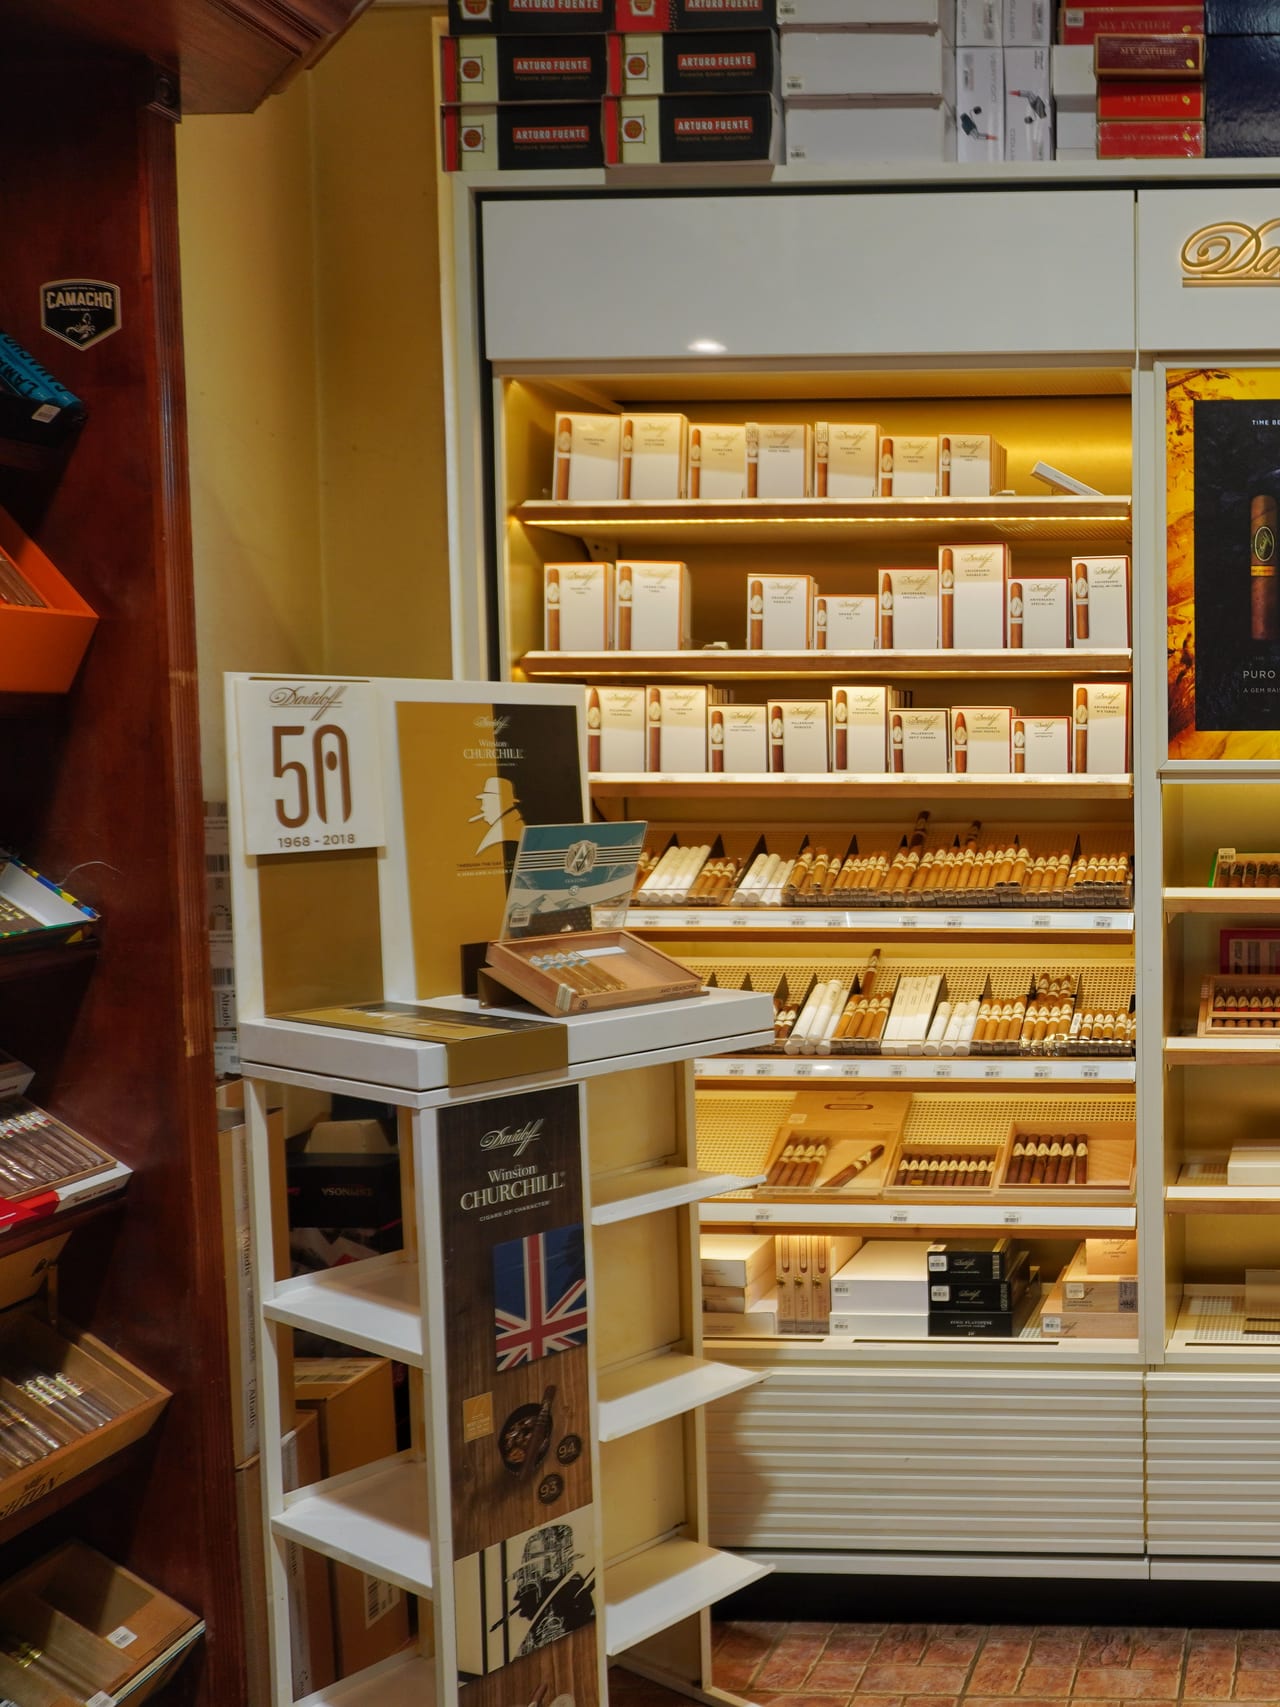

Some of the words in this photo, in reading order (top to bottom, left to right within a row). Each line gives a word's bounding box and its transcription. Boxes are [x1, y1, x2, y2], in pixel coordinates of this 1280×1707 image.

[513, 0, 554, 8] ARTURO
[557, 0, 599, 8] FUENTE
[688, 0, 723, 8] ARTURO
[725, 0, 759, 8] FUENTE
[961, 0, 969, 40] VERTIG
[1098, 21, 1116, 30] MY
[1121, 20, 1171, 30] FATHER
[1120, 47, 1135, 55] MY
[1138, 47, 1177, 56] FATHER
[516, 61, 551, 70] ARTURO
[553, 60, 588, 70] FUENTE
[681, 56, 715, 67] ARTURO
[718, 55, 752, 66] FUENTE
[678, 120, 713, 130] ARTURO
[715, 119, 749, 129] FUENTE
[516, 129, 550, 139] ARTURO
[552, 128, 586, 139] FUENTE
[46, 291, 113, 310] CAMACHO
[1242, 670, 1276, 679] PURO
[269, 686, 348, 722] Davidoff
[463, 748, 524, 760] CHURCHILL
[278, 836, 311, 849] 1968
[322, 834, 356, 846] 2018
[479, 1118, 545, 1158] Davidoff
[488, 1165, 537, 1184] Winston
[460, 1172, 565, 1212] CHURCHILL
[479, 1211, 503, 1222] CIGARS
[503, 1208, 513, 1216] OF
[514, 1200, 551, 1213] CHARACTER
